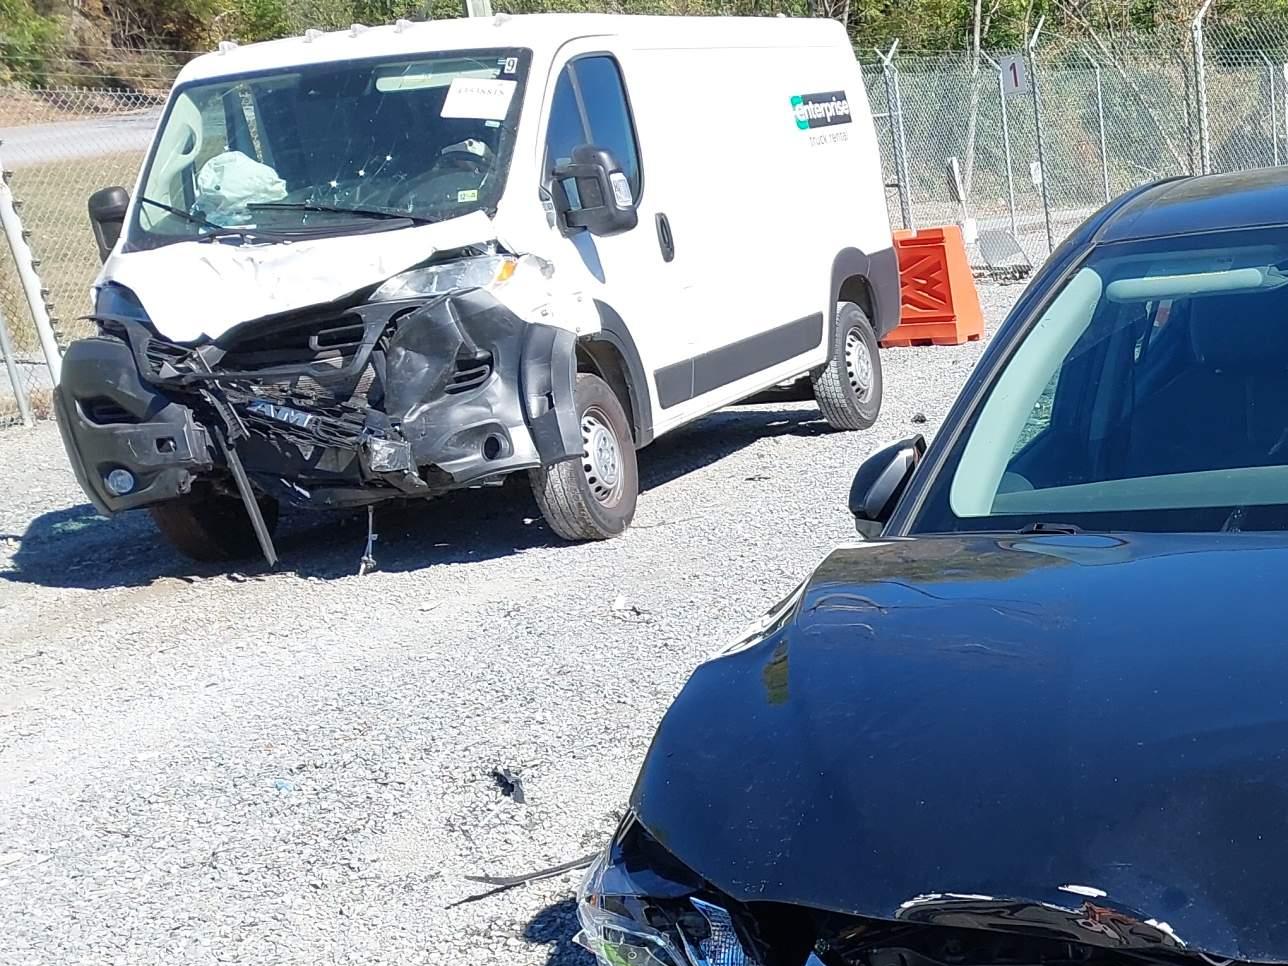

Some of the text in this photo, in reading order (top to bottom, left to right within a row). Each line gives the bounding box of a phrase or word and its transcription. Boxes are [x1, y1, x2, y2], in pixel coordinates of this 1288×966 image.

[506, 58, 515, 71] 9
[1009, 62, 1018, 87] 1
[794, 95, 850, 123] enterprise
[248, 402, 312, 428] AM
